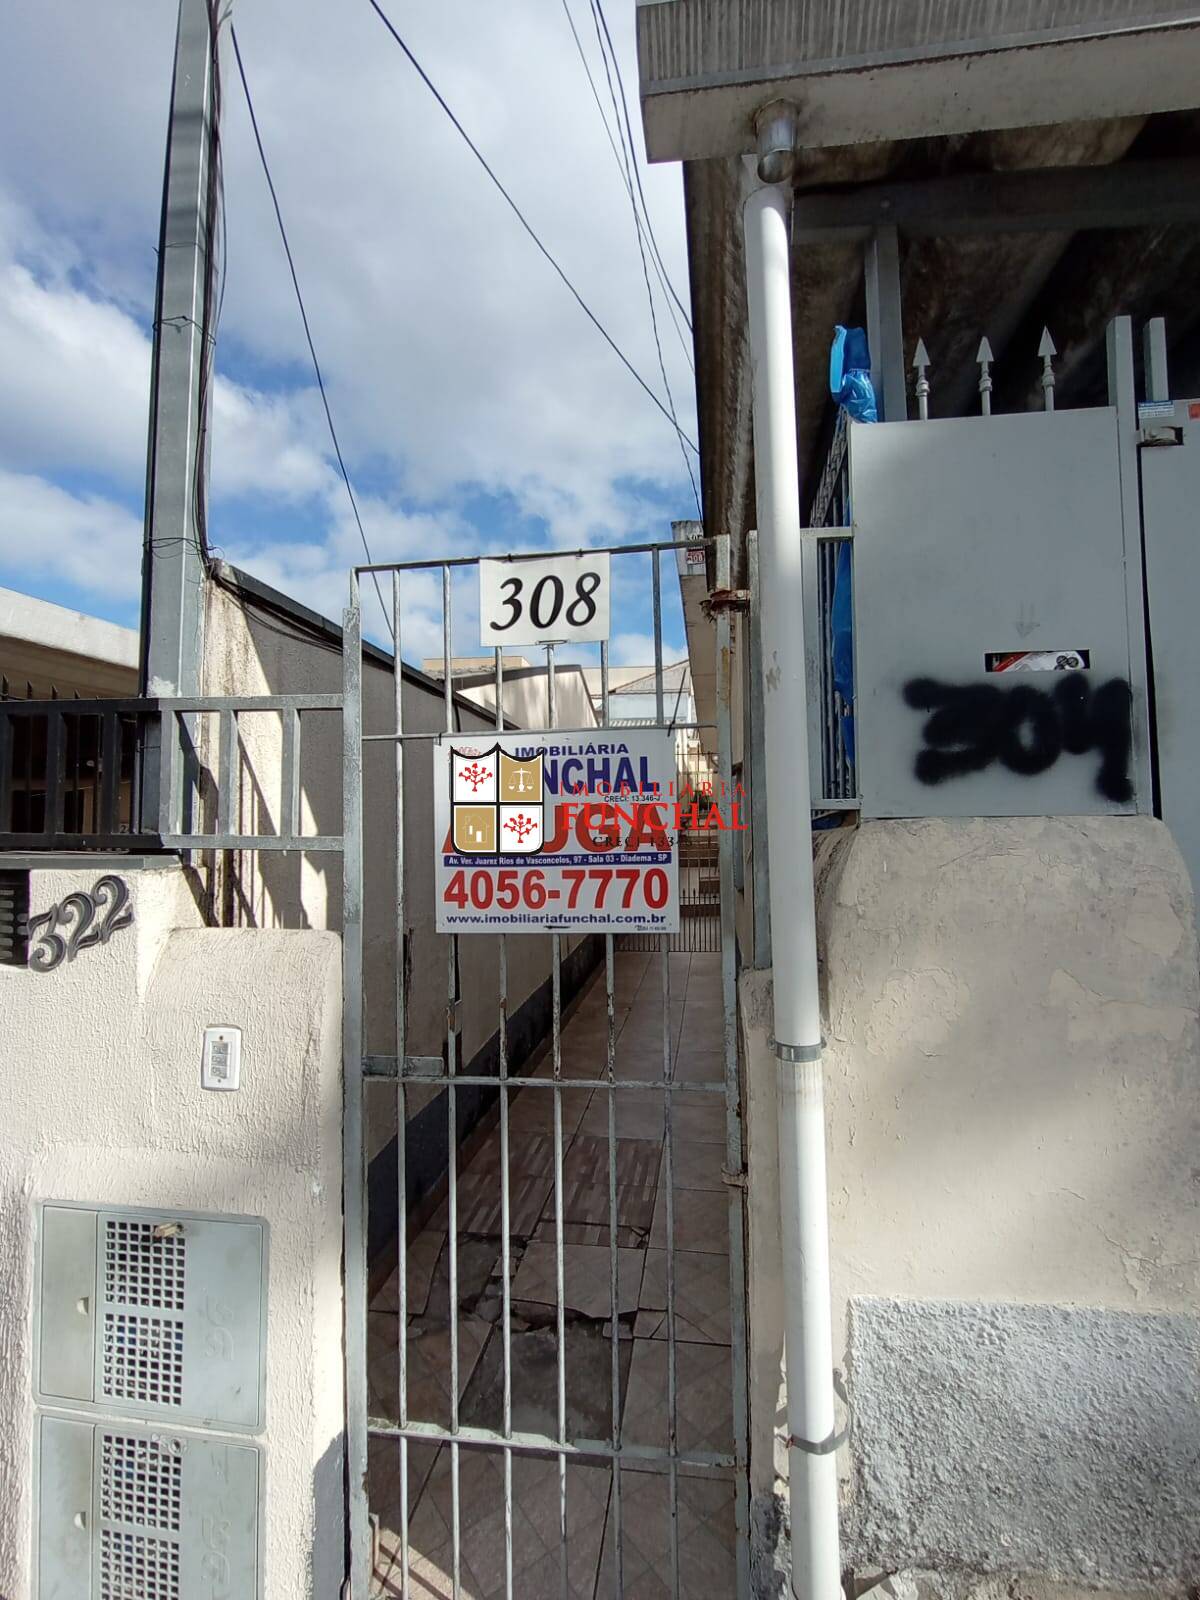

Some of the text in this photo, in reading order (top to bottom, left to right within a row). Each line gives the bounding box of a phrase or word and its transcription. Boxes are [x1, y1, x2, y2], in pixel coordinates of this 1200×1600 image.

[490, 571, 601, 631] 308
[515, 742, 629, 757] IMOBILIÁRIA
[903, 672, 1134, 802] 304
[516, 857, 524, 865] de
[573, 855, 582, 864] 97
[588, 855, 604, 863] Sala
[605, 855, 615, 863] 03
[620, 854, 651, 862] Diadema
[658, 853, 668, 861] SP
[443, 868, 669, 910] 4056-7770
[27, 875, 135, 973] 322
[446, 913, 666, 924] www.imobiliariafunchal.com.br
